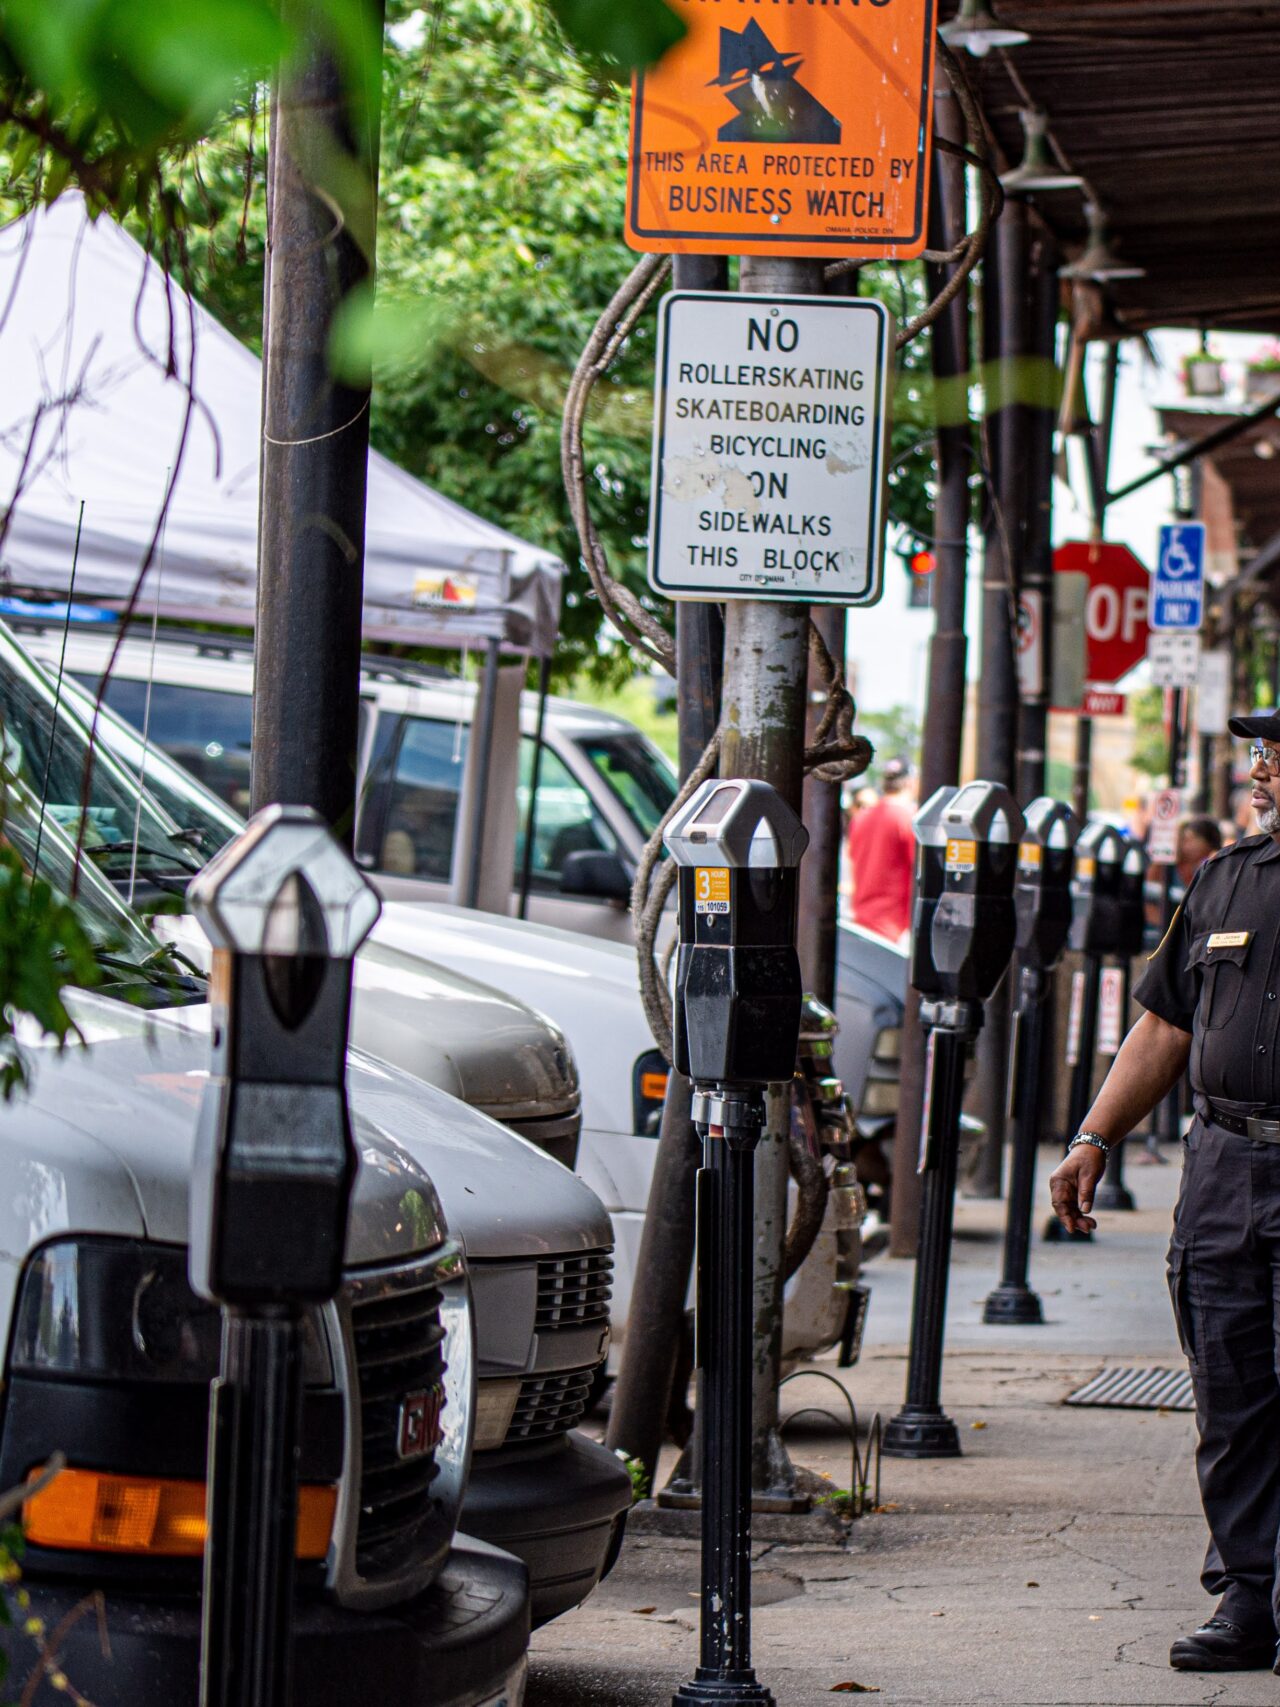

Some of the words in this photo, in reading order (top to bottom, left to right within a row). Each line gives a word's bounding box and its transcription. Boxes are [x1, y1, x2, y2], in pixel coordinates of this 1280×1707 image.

[645, 152, 684, 173] THIS
[696, 154, 748, 174] AREA
[763, 155, 874, 177] PROTECTED
[890, 159, 914, 179] BY
[669, 185, 792, 215] BUSINESS
[807, 190, 884, 218] WATCH
[747, 318, 799, 352] NO
[679, 363, 864, 391] ROLLERSKATING
[676, 398, 865, 426] SKATEBOARDING
[710, 434, 827, 459] BICYCLING
[747, 471, 788, 499] ON
[699, 511, 832, 536] SIDEWALKS
[687, 546, 738, 567] THIS
[763, 549, 840, 572] BLOCK
[1086, 583, 1150, 643] OP
[698, 870, 710, 899] 3
